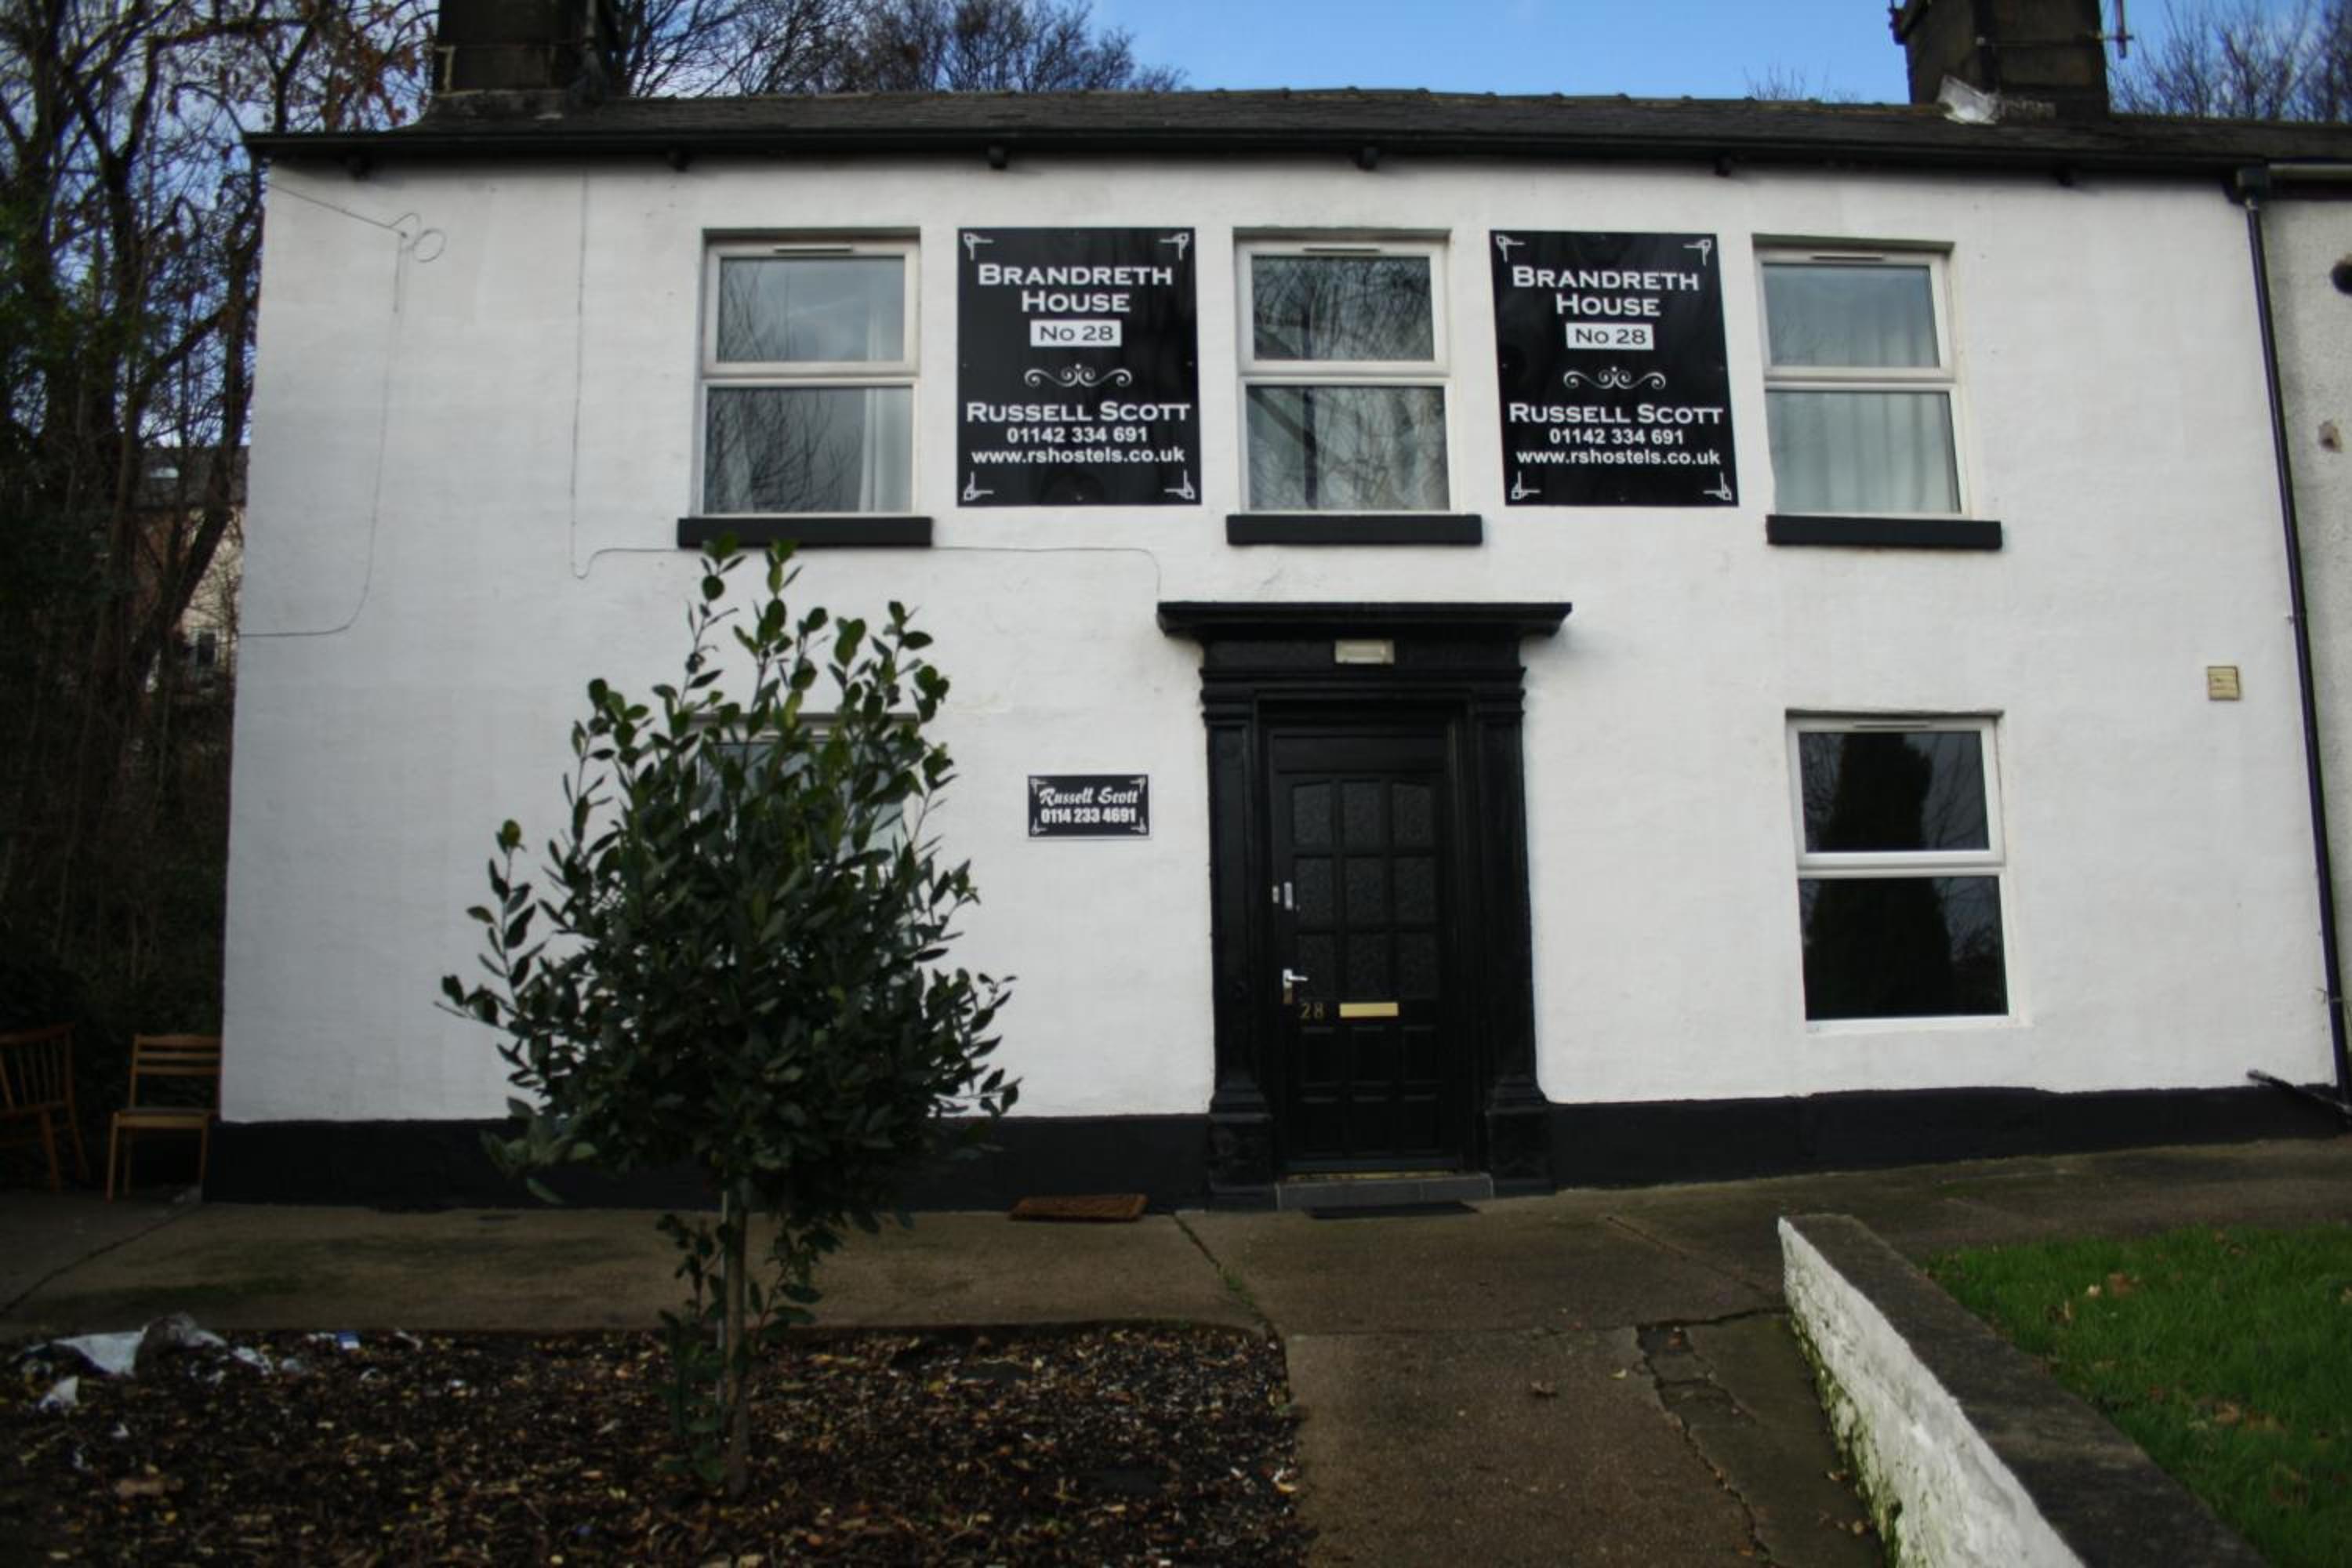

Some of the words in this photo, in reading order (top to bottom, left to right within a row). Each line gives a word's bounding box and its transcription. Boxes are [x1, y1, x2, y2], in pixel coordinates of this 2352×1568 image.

[978, 263, 1173, 285] BRANDRETH
[1512, 265, 1700, 291] BRANDRETH
[1022, 290, 1131, 313] HOUSE
[1555, 293, 1661, 317] HOUSE
[1082, 325, 1114, 342] 28
[1616, 329, 1646, 345] 28
[967, 401, 1092, 423] RUSSELL
[1099, 401, 1191, 422] SCOTT
[1509, 402, 1631, 423] RUSSELL
[1637, 404, 1724, 424] SCOTT
[1007, 427, 1065, 444] 01142
[1072, 426, 1107, 443] 334
[1113, 426, 1147, 443] 691
[1549, 428, 1606, 445] 01142
[1611, 428, 1646, 445] 334
[1651, 429, 1684, 445] 691
[971, 446, 1185, 464] www.rshostels.co.uk
[1516, 448, 1721, 466] www.rshostels.co.uk
[1039, 786, 1094, 806] Russell
[1098, 786, 1138, 804] Scott
[1040, 808, 1072, 823] 0114
[1073, 808, 1100, 823] 233
[1102, 808, 1136, 822] 4691
[1300, 1003, 1325, 1019] 28
